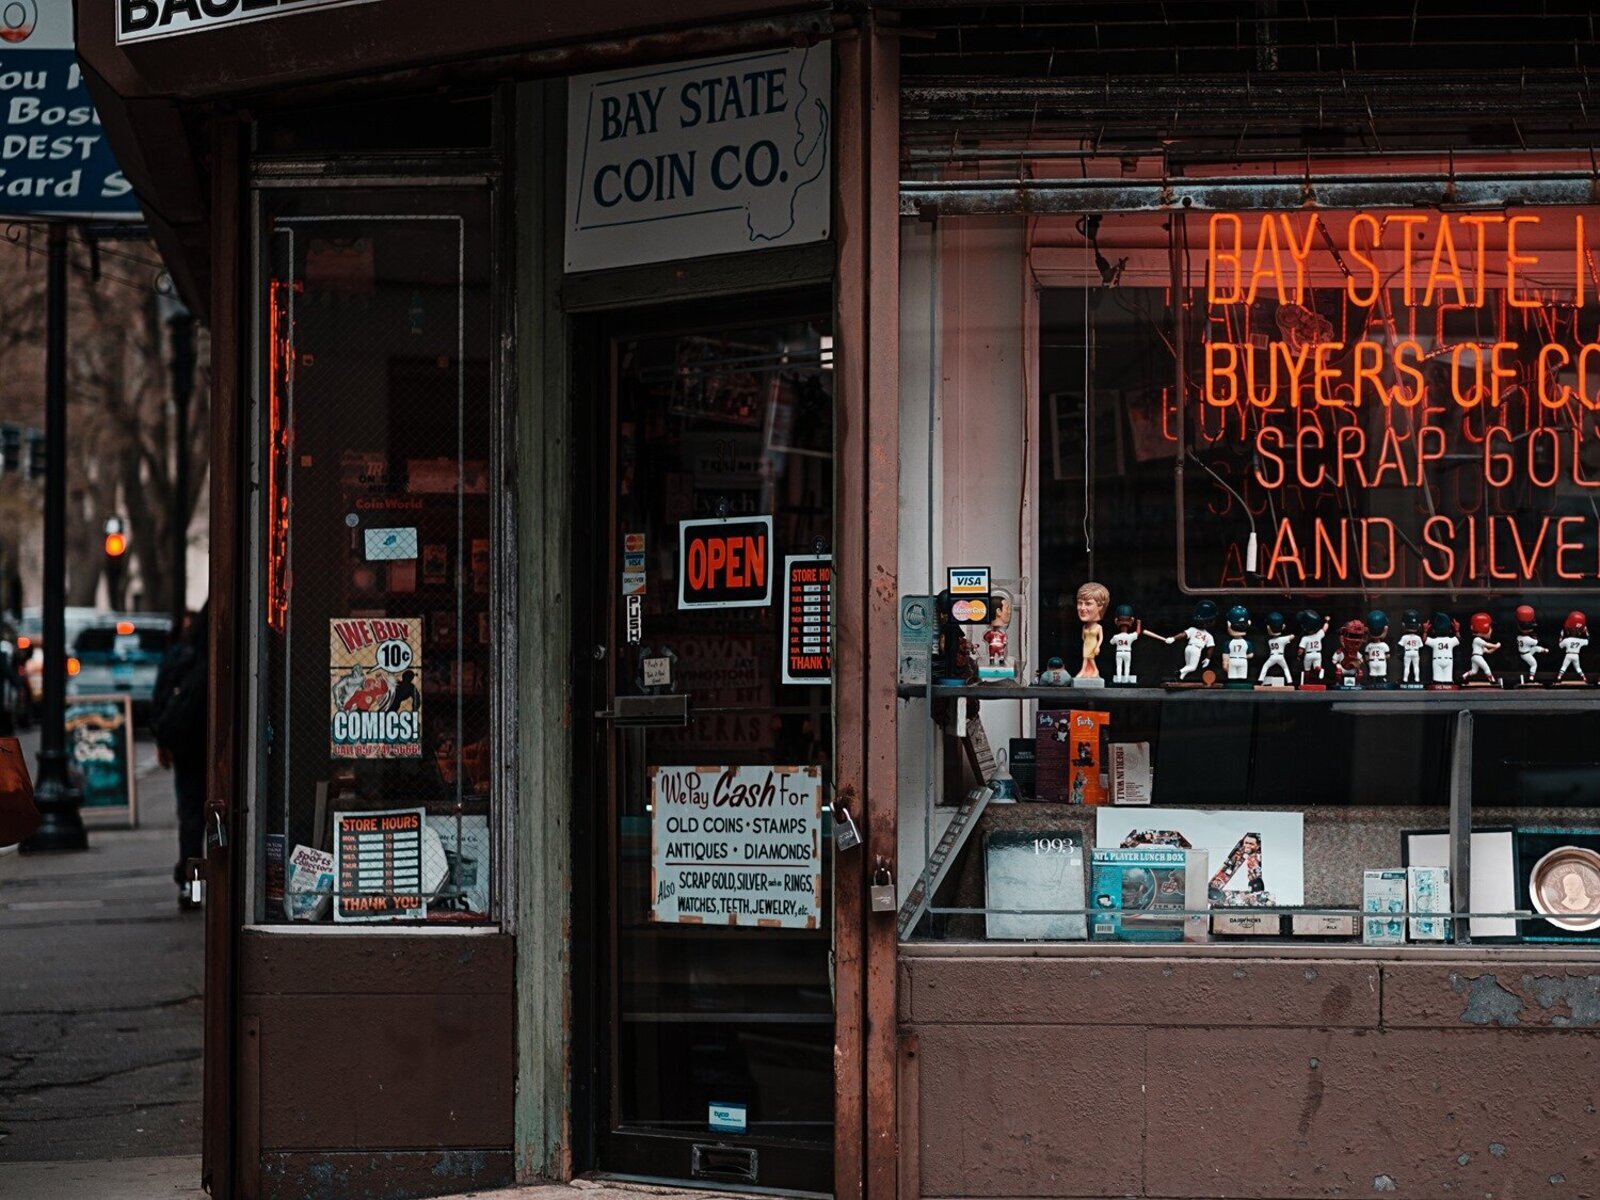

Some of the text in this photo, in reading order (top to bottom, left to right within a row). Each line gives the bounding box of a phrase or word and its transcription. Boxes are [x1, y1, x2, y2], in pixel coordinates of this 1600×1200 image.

[600, 67, 789, 143] BAY STATE
[0, 134, 101, 161] DEST
[593, 139, 789, 208] COIN CO.
[1208, 213, 1320, 306] BAY
[1348, 213, 1541, 308] STATE
[1204, 341, 1426, 409] BUYERS
[1451, 341, 1519, 409] OF
[1255, 426, 1447, 489] SCRAP
[1267, 516, 1396, 580] AND
[687, 535, 765, 592] OPEN
[791, 567, 817, 583] STORE
[956, 577, 982, 586] VISA
[629, 596, 640, 642] PUSH
[333, 620, 409, 655] WE BUY
[1118, 639, 1129, 647] 34
[1309, 640, 1319, 649] 12
[1437, 642, 1449, 651] 34
[1569, 641, 1581, 649] 27
[1232, 644, 1242, 653] 17
[1371, 650, 1380, 658] 45
[791, 655, 824, 670] THANK
[332, 710, 420, 744] COMICS!
[1076, 716, 1095, 729] Furby
[1116, 751, 1125, 779] BERLIN
[661, 769, 810, 810] We Pay Cash For
[1116, 780, 1125, 801] WALL
[342, 815, 419, 832] STORE HOURS
[666, 816, 807, 834] OLD COINS STAMPS
[666, 842, 811, 861] ANTIQUES DIAMONDS
[1031, 837, 1075, 856] 1993
[296, 850, 332, 867] Sports
[1093, 852, 1185, 862] NFL PLAYER LUNCH BOX
[657, 880, 676, 904] Also
[678, 871, 711, 890] SCRAP
[736, 872, 768, 891] SILVER
[784, 873, 815, 895] RINGS,
[342, 896, 419, 911] THANK YOU
[677, 895, 720, 915] WATCHES,
[752, 899, 798, 918] JEWELRY,
[713, 1110, 730, 1119] tyco
